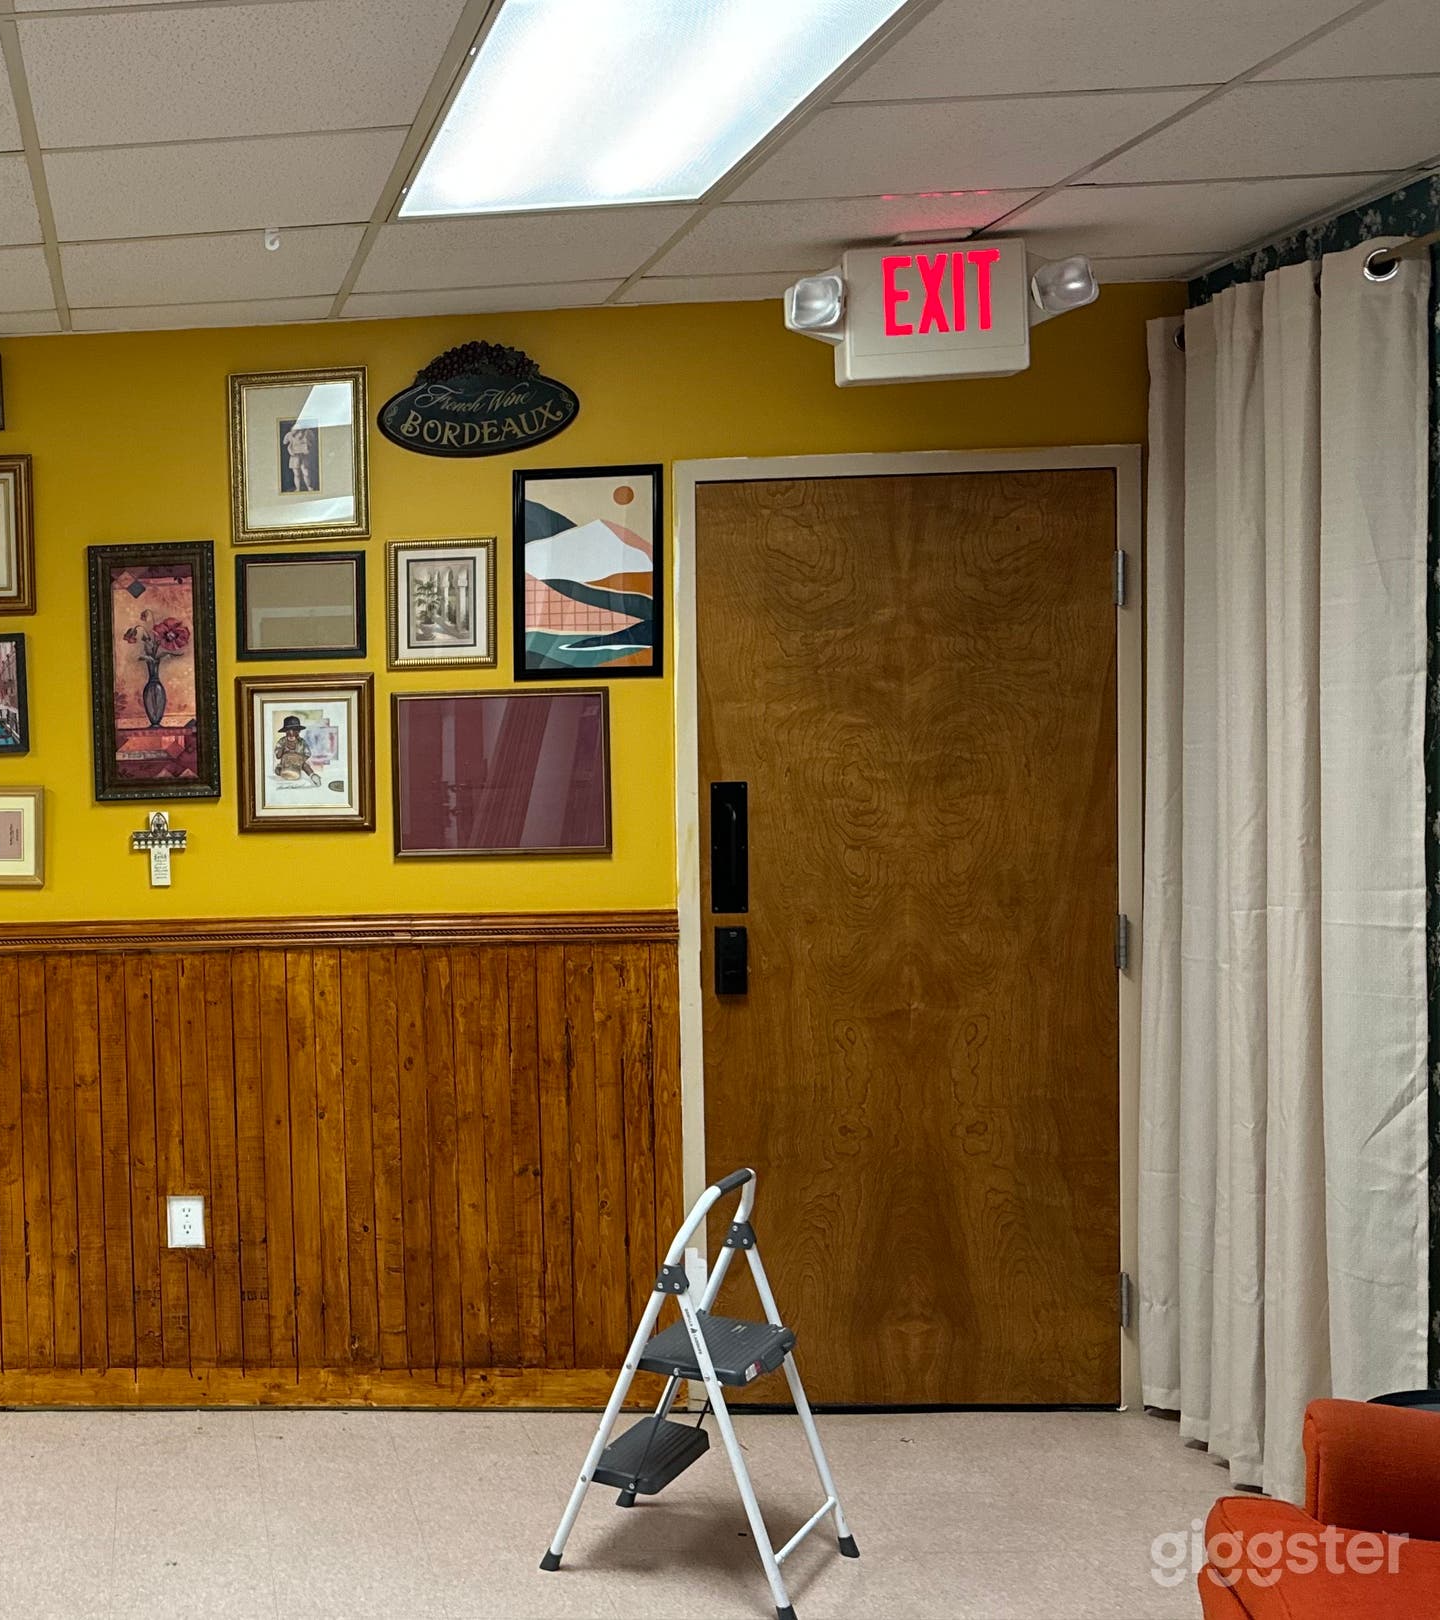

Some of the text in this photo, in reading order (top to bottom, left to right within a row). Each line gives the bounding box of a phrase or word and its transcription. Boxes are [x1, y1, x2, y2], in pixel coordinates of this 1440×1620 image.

[881, 248, 1000, 337] EXIT
[414, 382, 534, 413] French Wine
[400, 400, 563, 448] BORDEAUX
